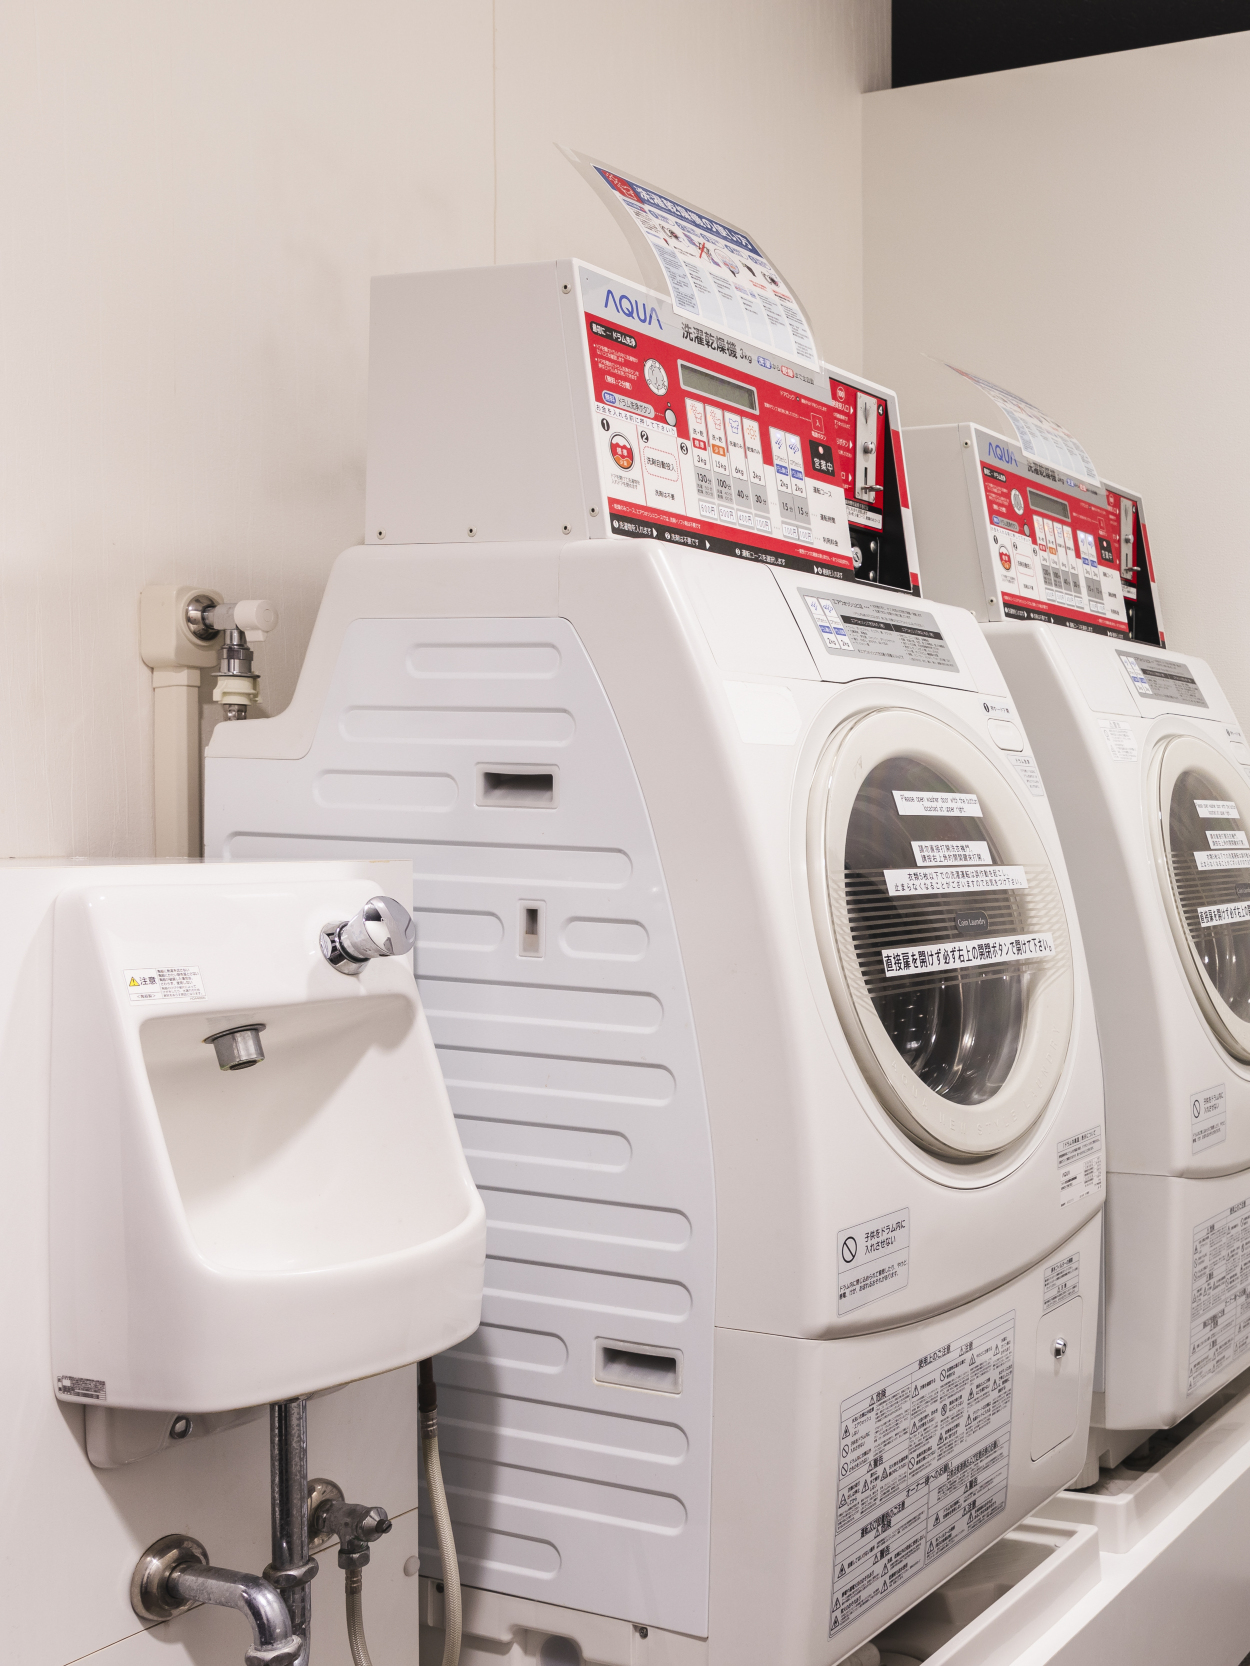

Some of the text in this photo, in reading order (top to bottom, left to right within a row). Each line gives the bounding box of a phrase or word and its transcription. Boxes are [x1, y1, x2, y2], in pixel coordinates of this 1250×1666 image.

[604, 290, 663, 330] AQUA
[682, 322, 738, 360] 洗濯乾燥機
[596, 404, 671, 434] お金を入れる前に押して下さい
[697, 454, 707, 465] 3kg
[813, 458, 833, 473] 営業中
[988, 442, 1018, 468] AQUA
[780, 480, 789, 489] 2kg
[794, 484, 803, 494] 2kg
[970, 918, 986, 927] Laundry
[884, 937, 1052, 973] 直接扉を開けず必ず右上の開閉ボタンで開けて下さい。
[139, 976, 157, 986] 注意
[864, 1220, 906, 1242] 子供をドラム内に
[864, 1236, 896, 1256] 入れさせない
[918, 1344, 951, 1369] 使用上のご注意
